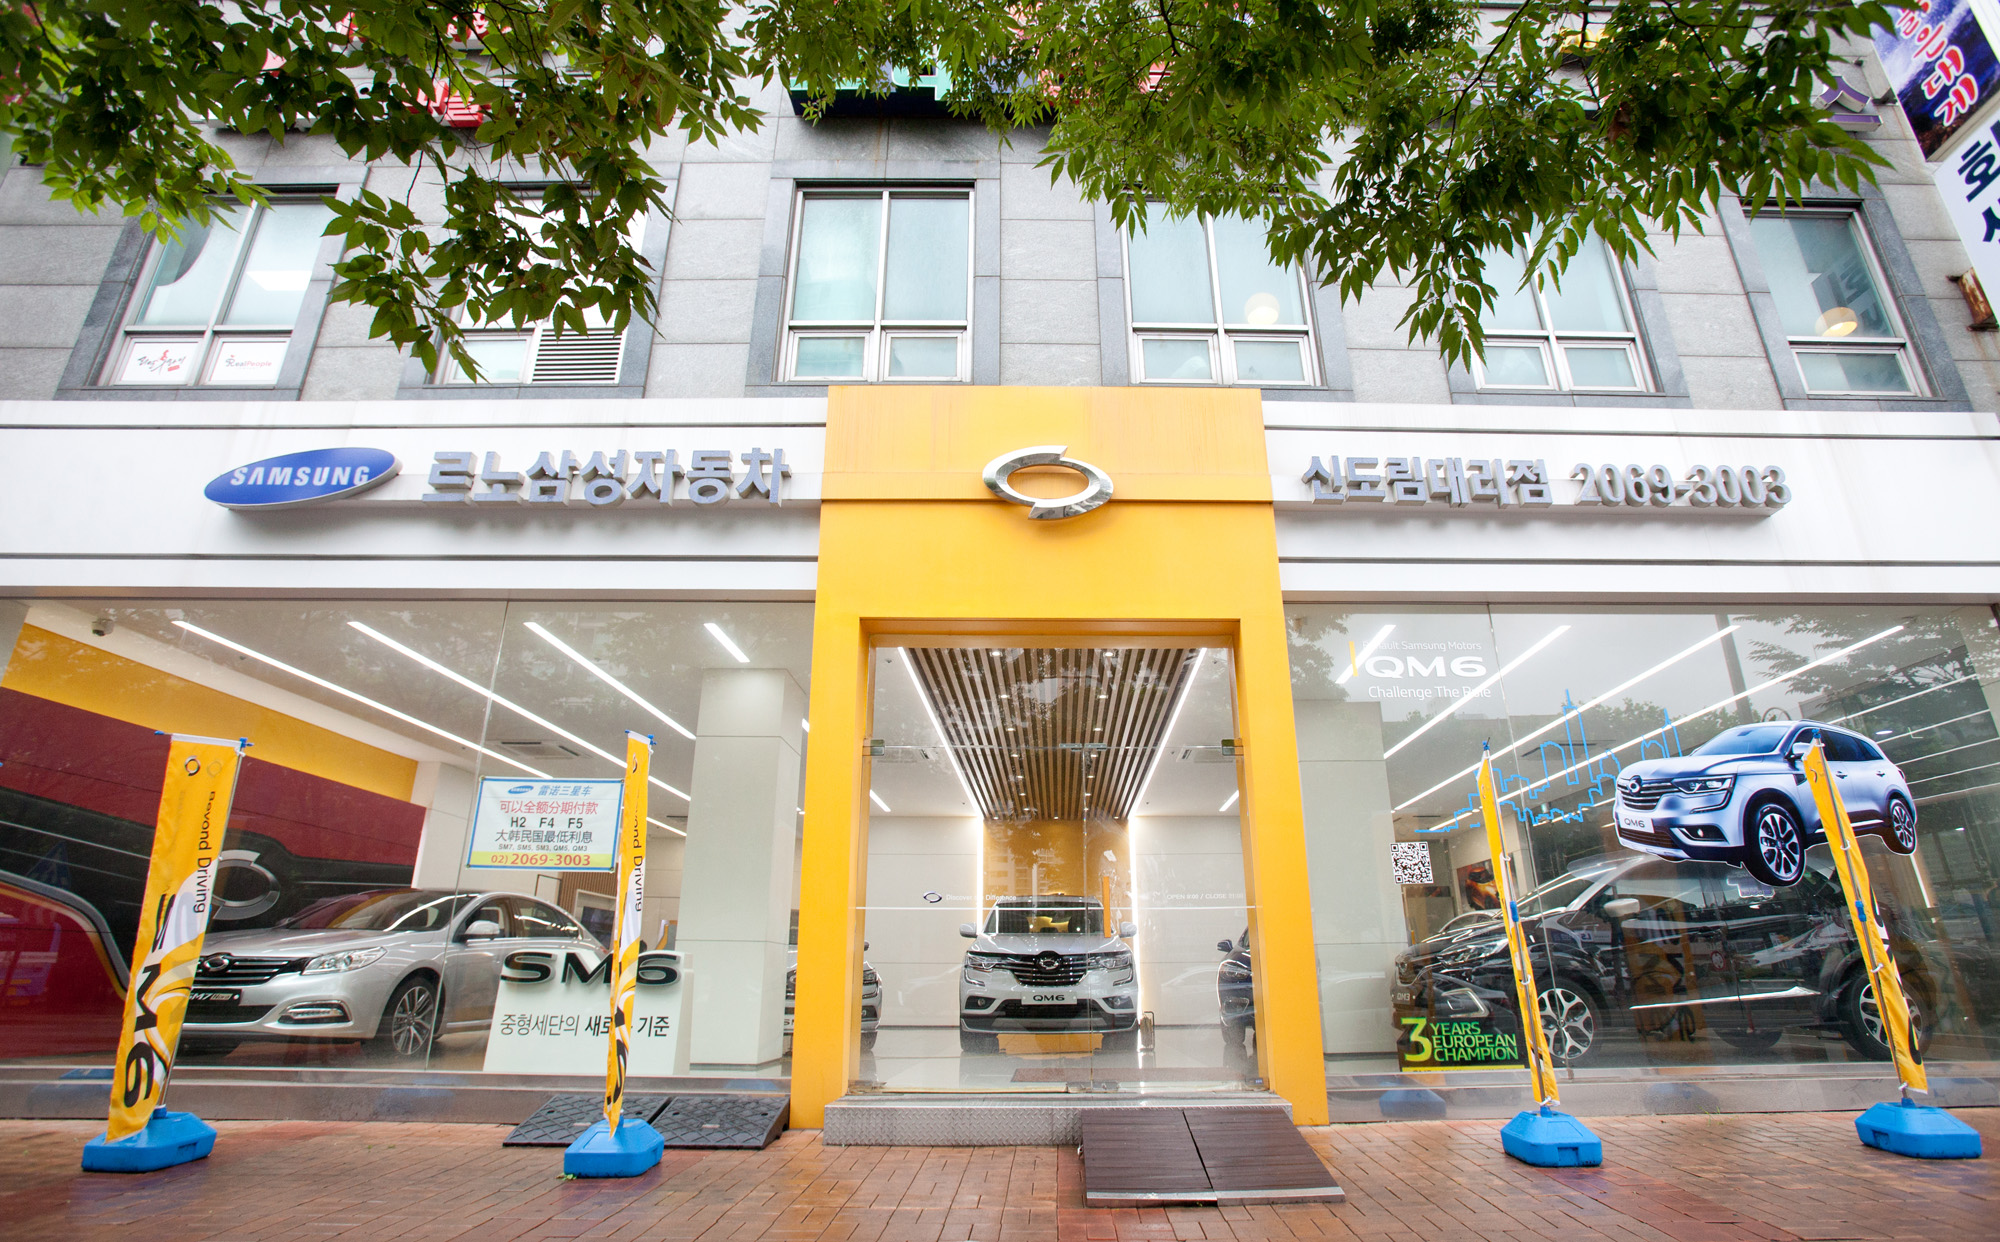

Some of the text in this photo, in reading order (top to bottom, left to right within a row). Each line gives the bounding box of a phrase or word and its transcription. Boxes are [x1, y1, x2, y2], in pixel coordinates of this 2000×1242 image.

[229, 465, 371, 487] SAMSUNG
[421, 446, 792, 507] 르노삼성자동차
[1301, 455, 1792, 509] 신도림대리점 2069-3003
[1401, 640, 1446, 652] Samsung
[1448, 640, 1482, 650] Motors
[1364, 656, 1487, 678] QM6
[1368, 686, 1432, 700] Challenge
[1435, 686, 1460, 698] The
[538, 785, 593, 796] 雷诺三星车
[500, 800, 599, 815] 可以全额分期付款
[510, 817, 583, 829] H2 F4 F5
[1624, 817, 1645, 828] QM6
[495, 830, 593, 843] 大韩民国最低利息
[491, 853, 591, 866] 02) 2069-3003
[194, 857, 212, 914] Driving
[500, 952, 679, 985] SM6
[1033, 994, 1065, 1002] QM6
[500, 1014, 670, 1037] 중형세단의 새로 기준
[1429, 1022, 1480, 1035] YEARS
[1401, 1017, 1432, 1062] 3
[1432, 1034, 1517, 1048] EUROPEAN
[1434, 1047, 1519, 1061] CHAMPION
